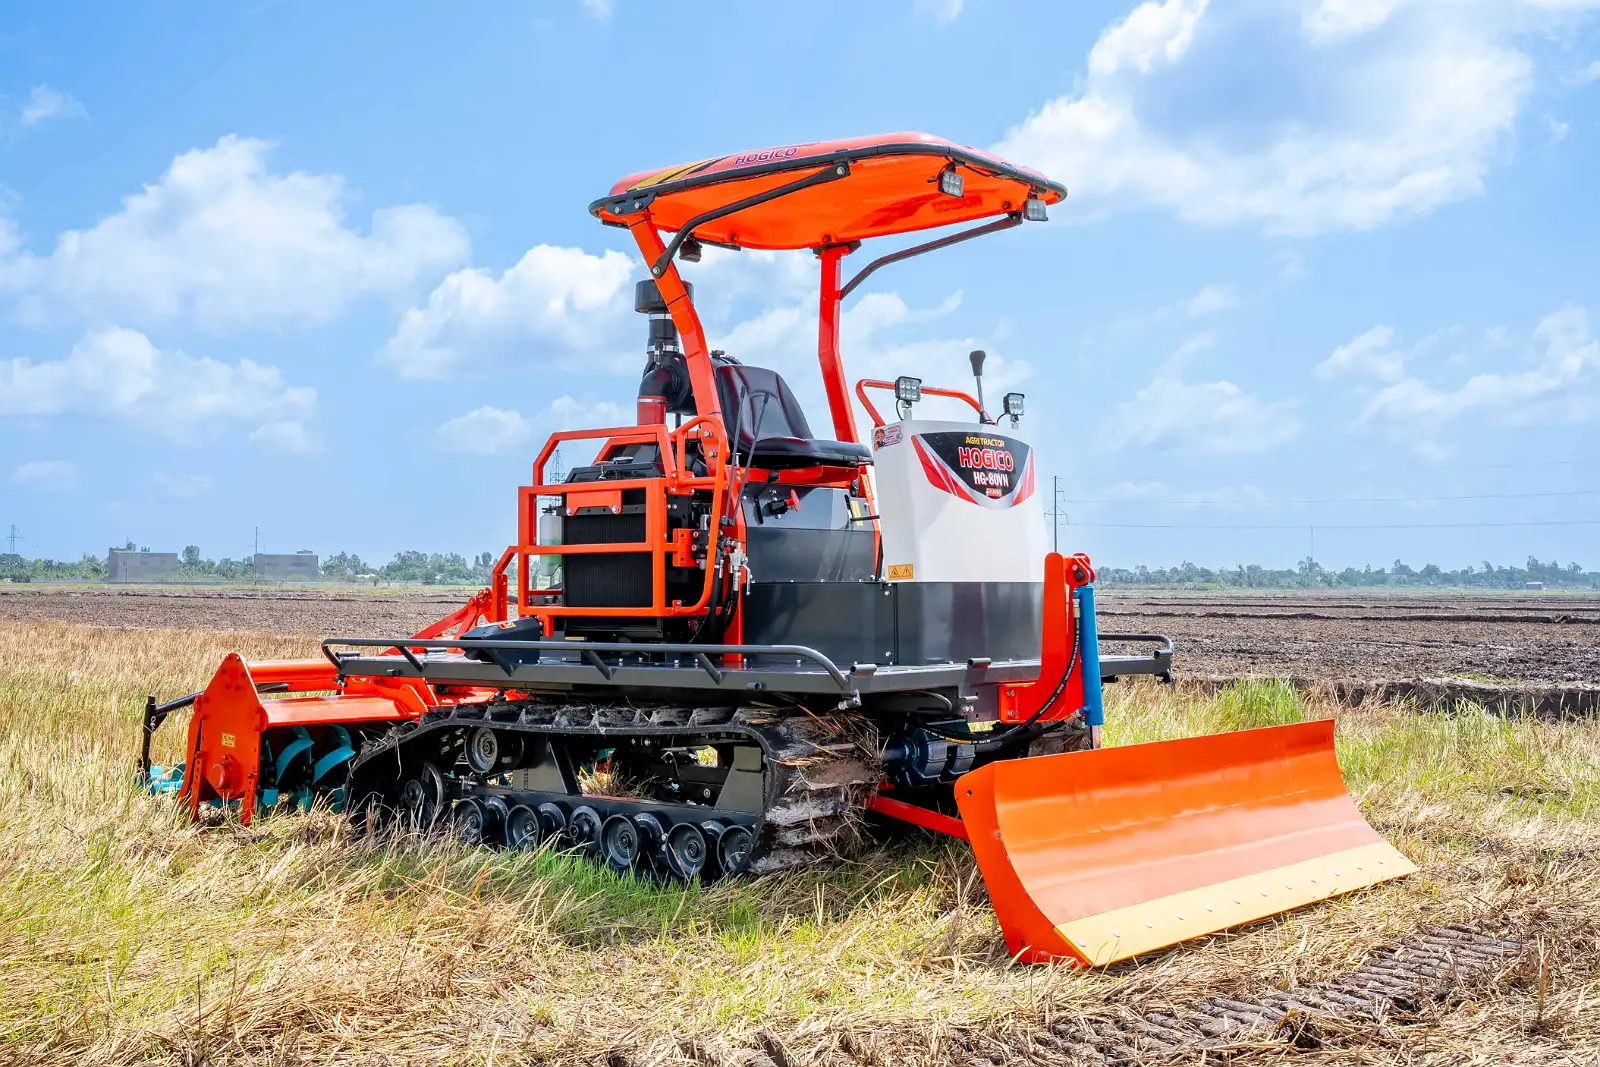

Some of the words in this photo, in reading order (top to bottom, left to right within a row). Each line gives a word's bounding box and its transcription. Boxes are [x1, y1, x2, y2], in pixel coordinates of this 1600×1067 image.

[734, 147, 798, 165] HOGICO
[965, 436, 979, 445] AGRI
[980, 438, 1005, 447] TRACTOR
[959, 447, 1014, 472] HOGICO
[973, 471, 1009, 487] HG-80VN
